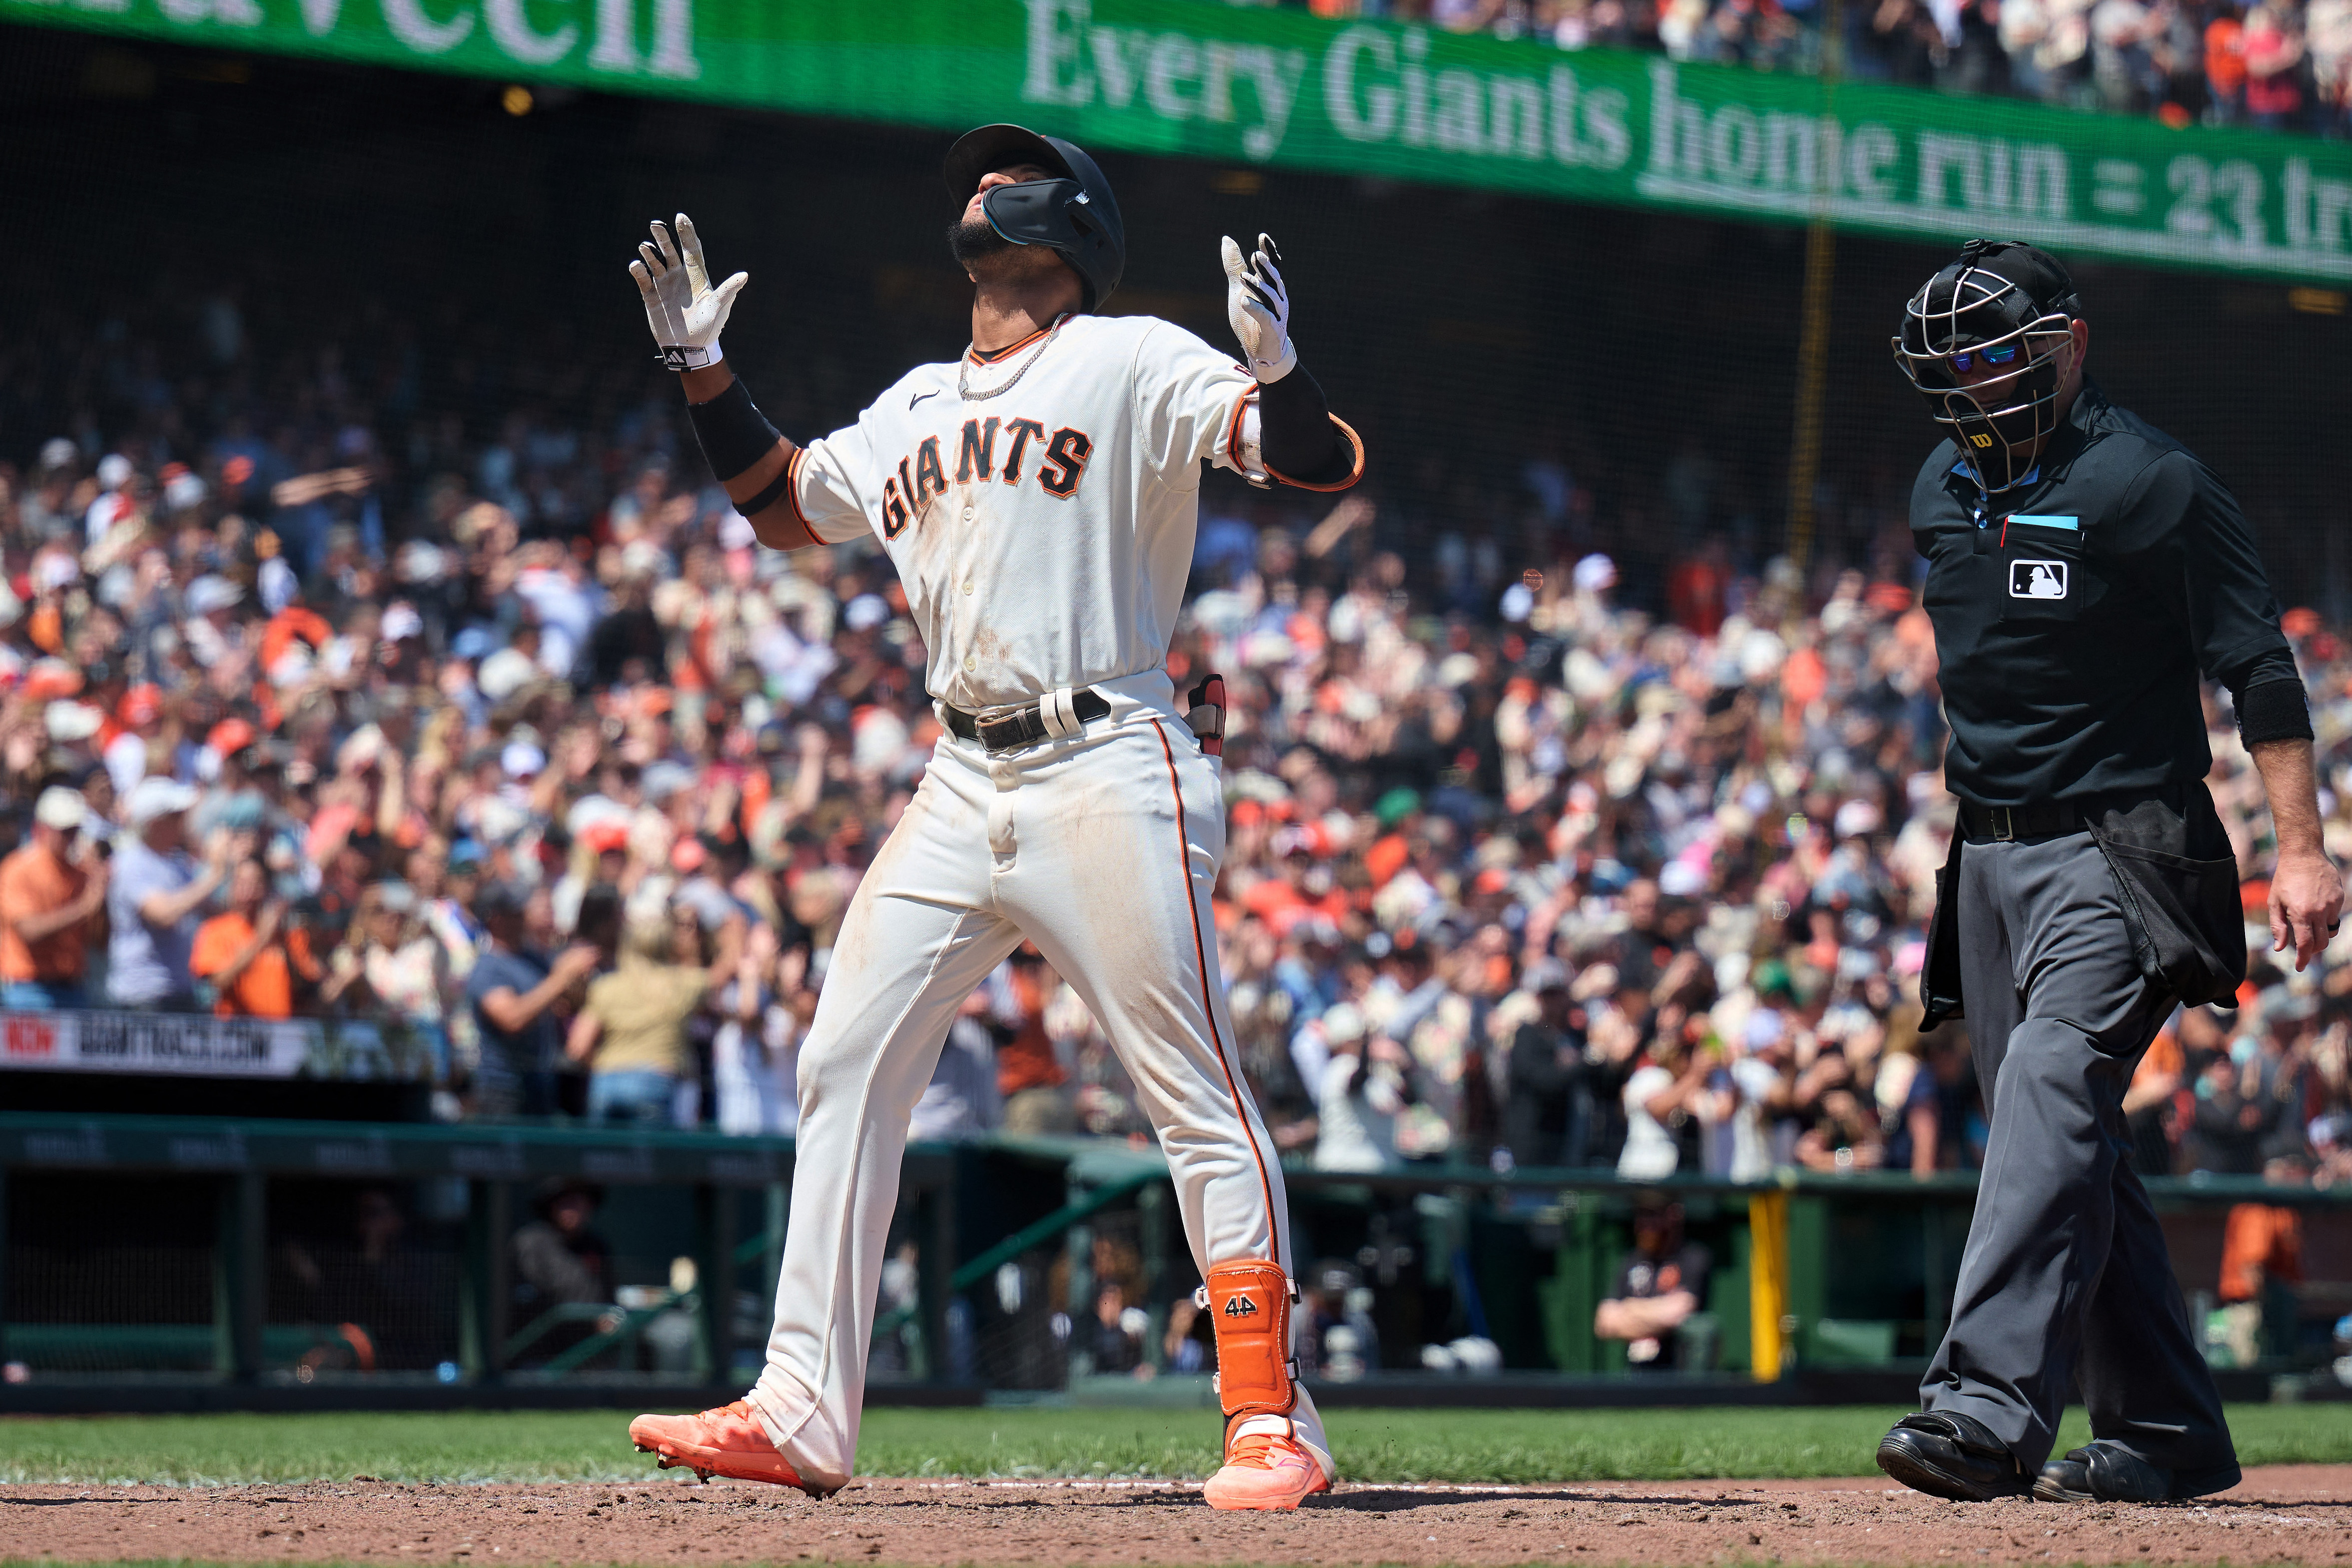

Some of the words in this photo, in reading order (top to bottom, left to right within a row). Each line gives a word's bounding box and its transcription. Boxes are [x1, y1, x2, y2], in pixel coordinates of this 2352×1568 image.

[1019, 0, 1304, 161] Every
[1323, 25, 1631, 172] Giants
[1648, 56, 1900, 200] home
[1917, 129, 2071, 223] run
[882, 416, 1093, 541] GIANTS
